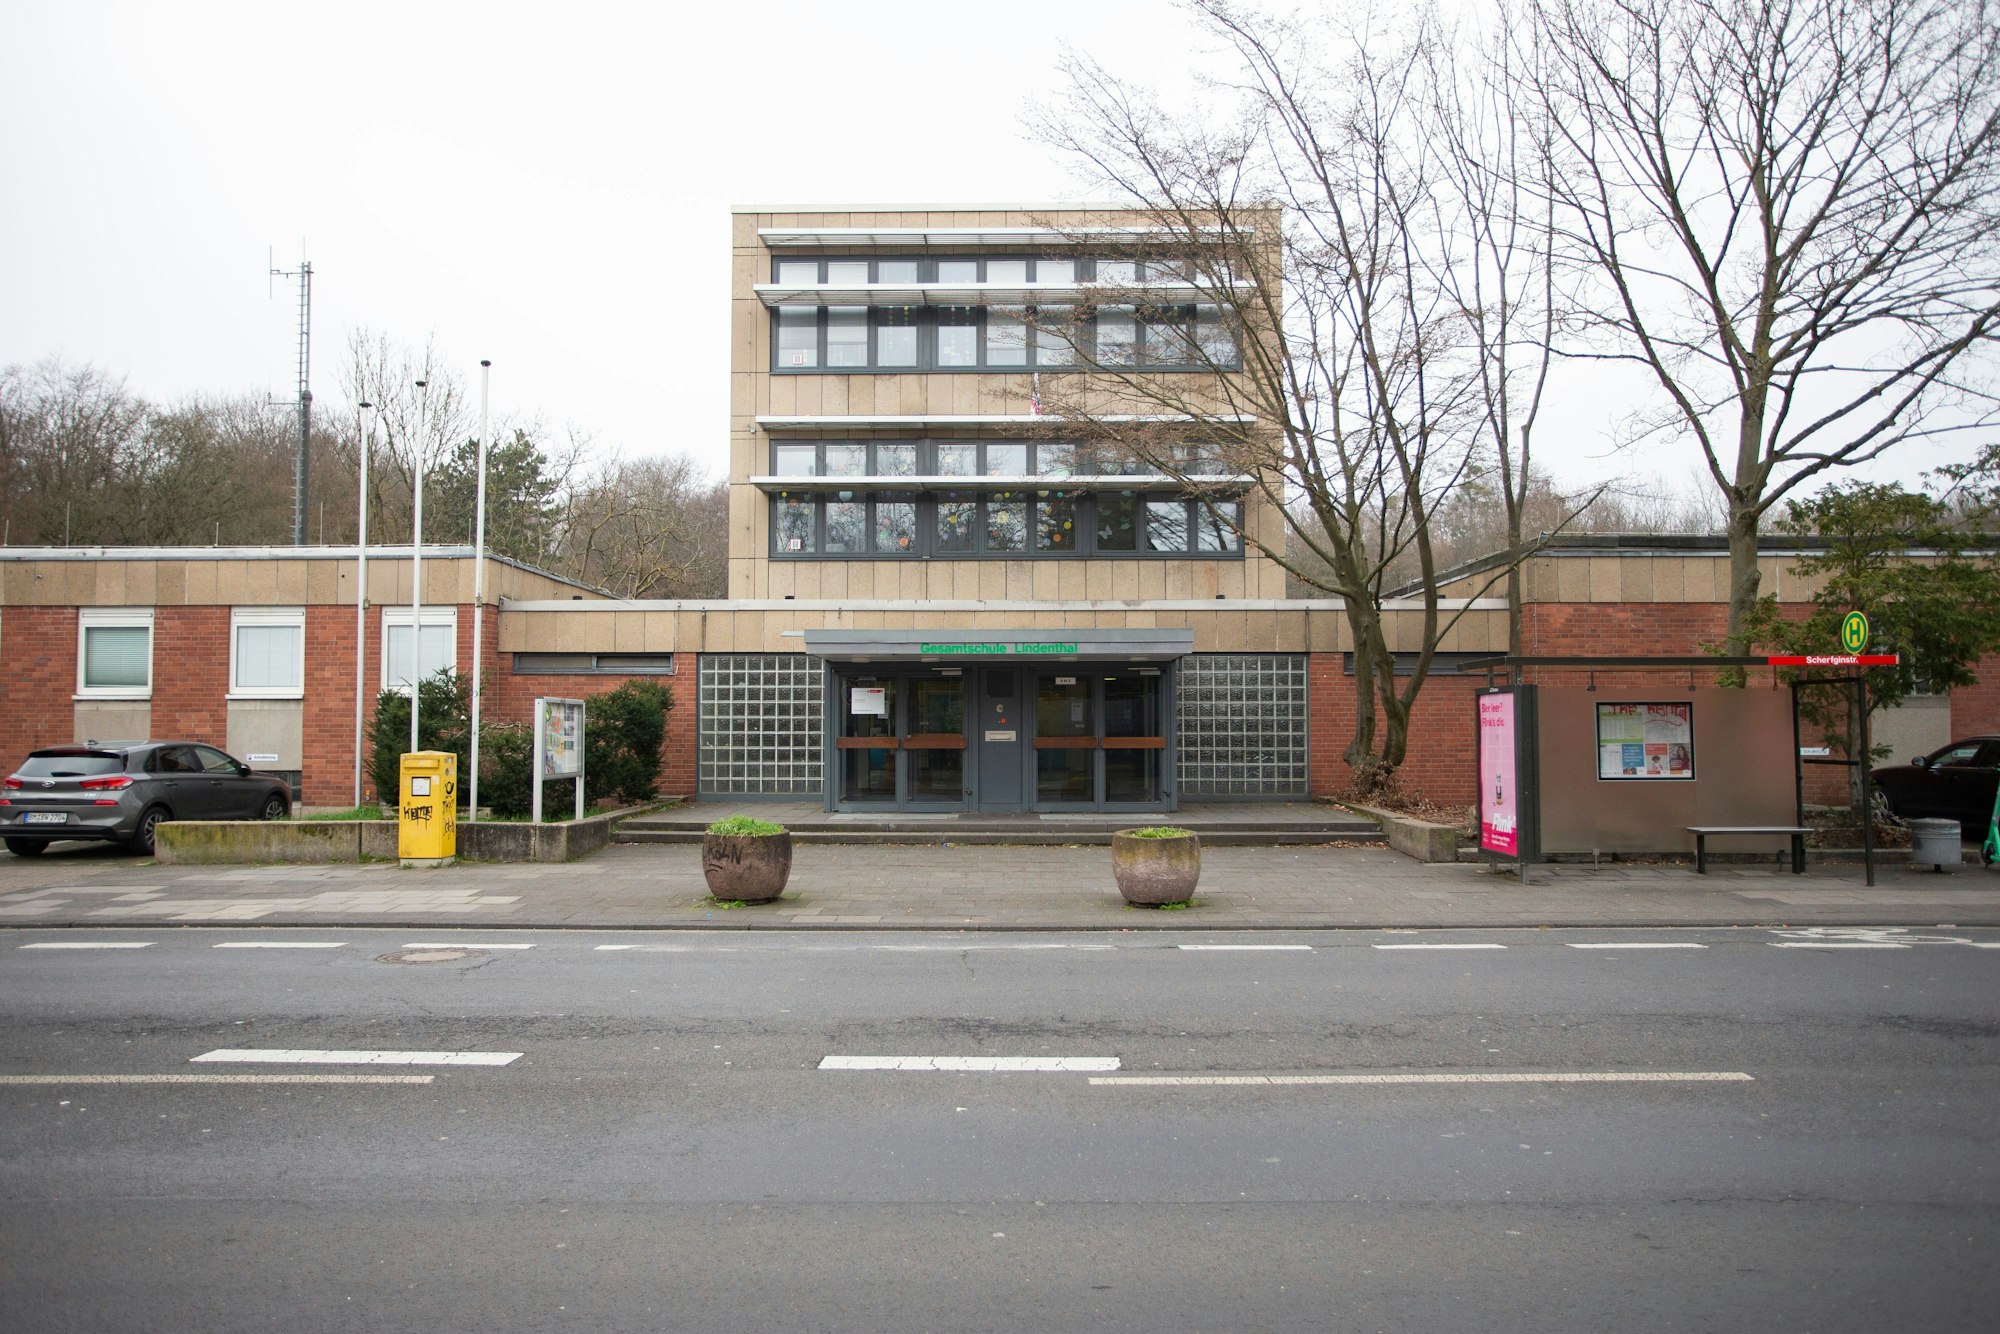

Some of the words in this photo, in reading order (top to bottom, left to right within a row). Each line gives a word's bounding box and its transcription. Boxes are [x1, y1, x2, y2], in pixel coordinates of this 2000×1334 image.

[920, 642, 1007, 654] Gesamtschule
[1014, 642, 1078, 654] Lindenthal
[1806, 656, 1858, 665] Scherfginstr.
[1491, 813, 1514, 834] Flink
